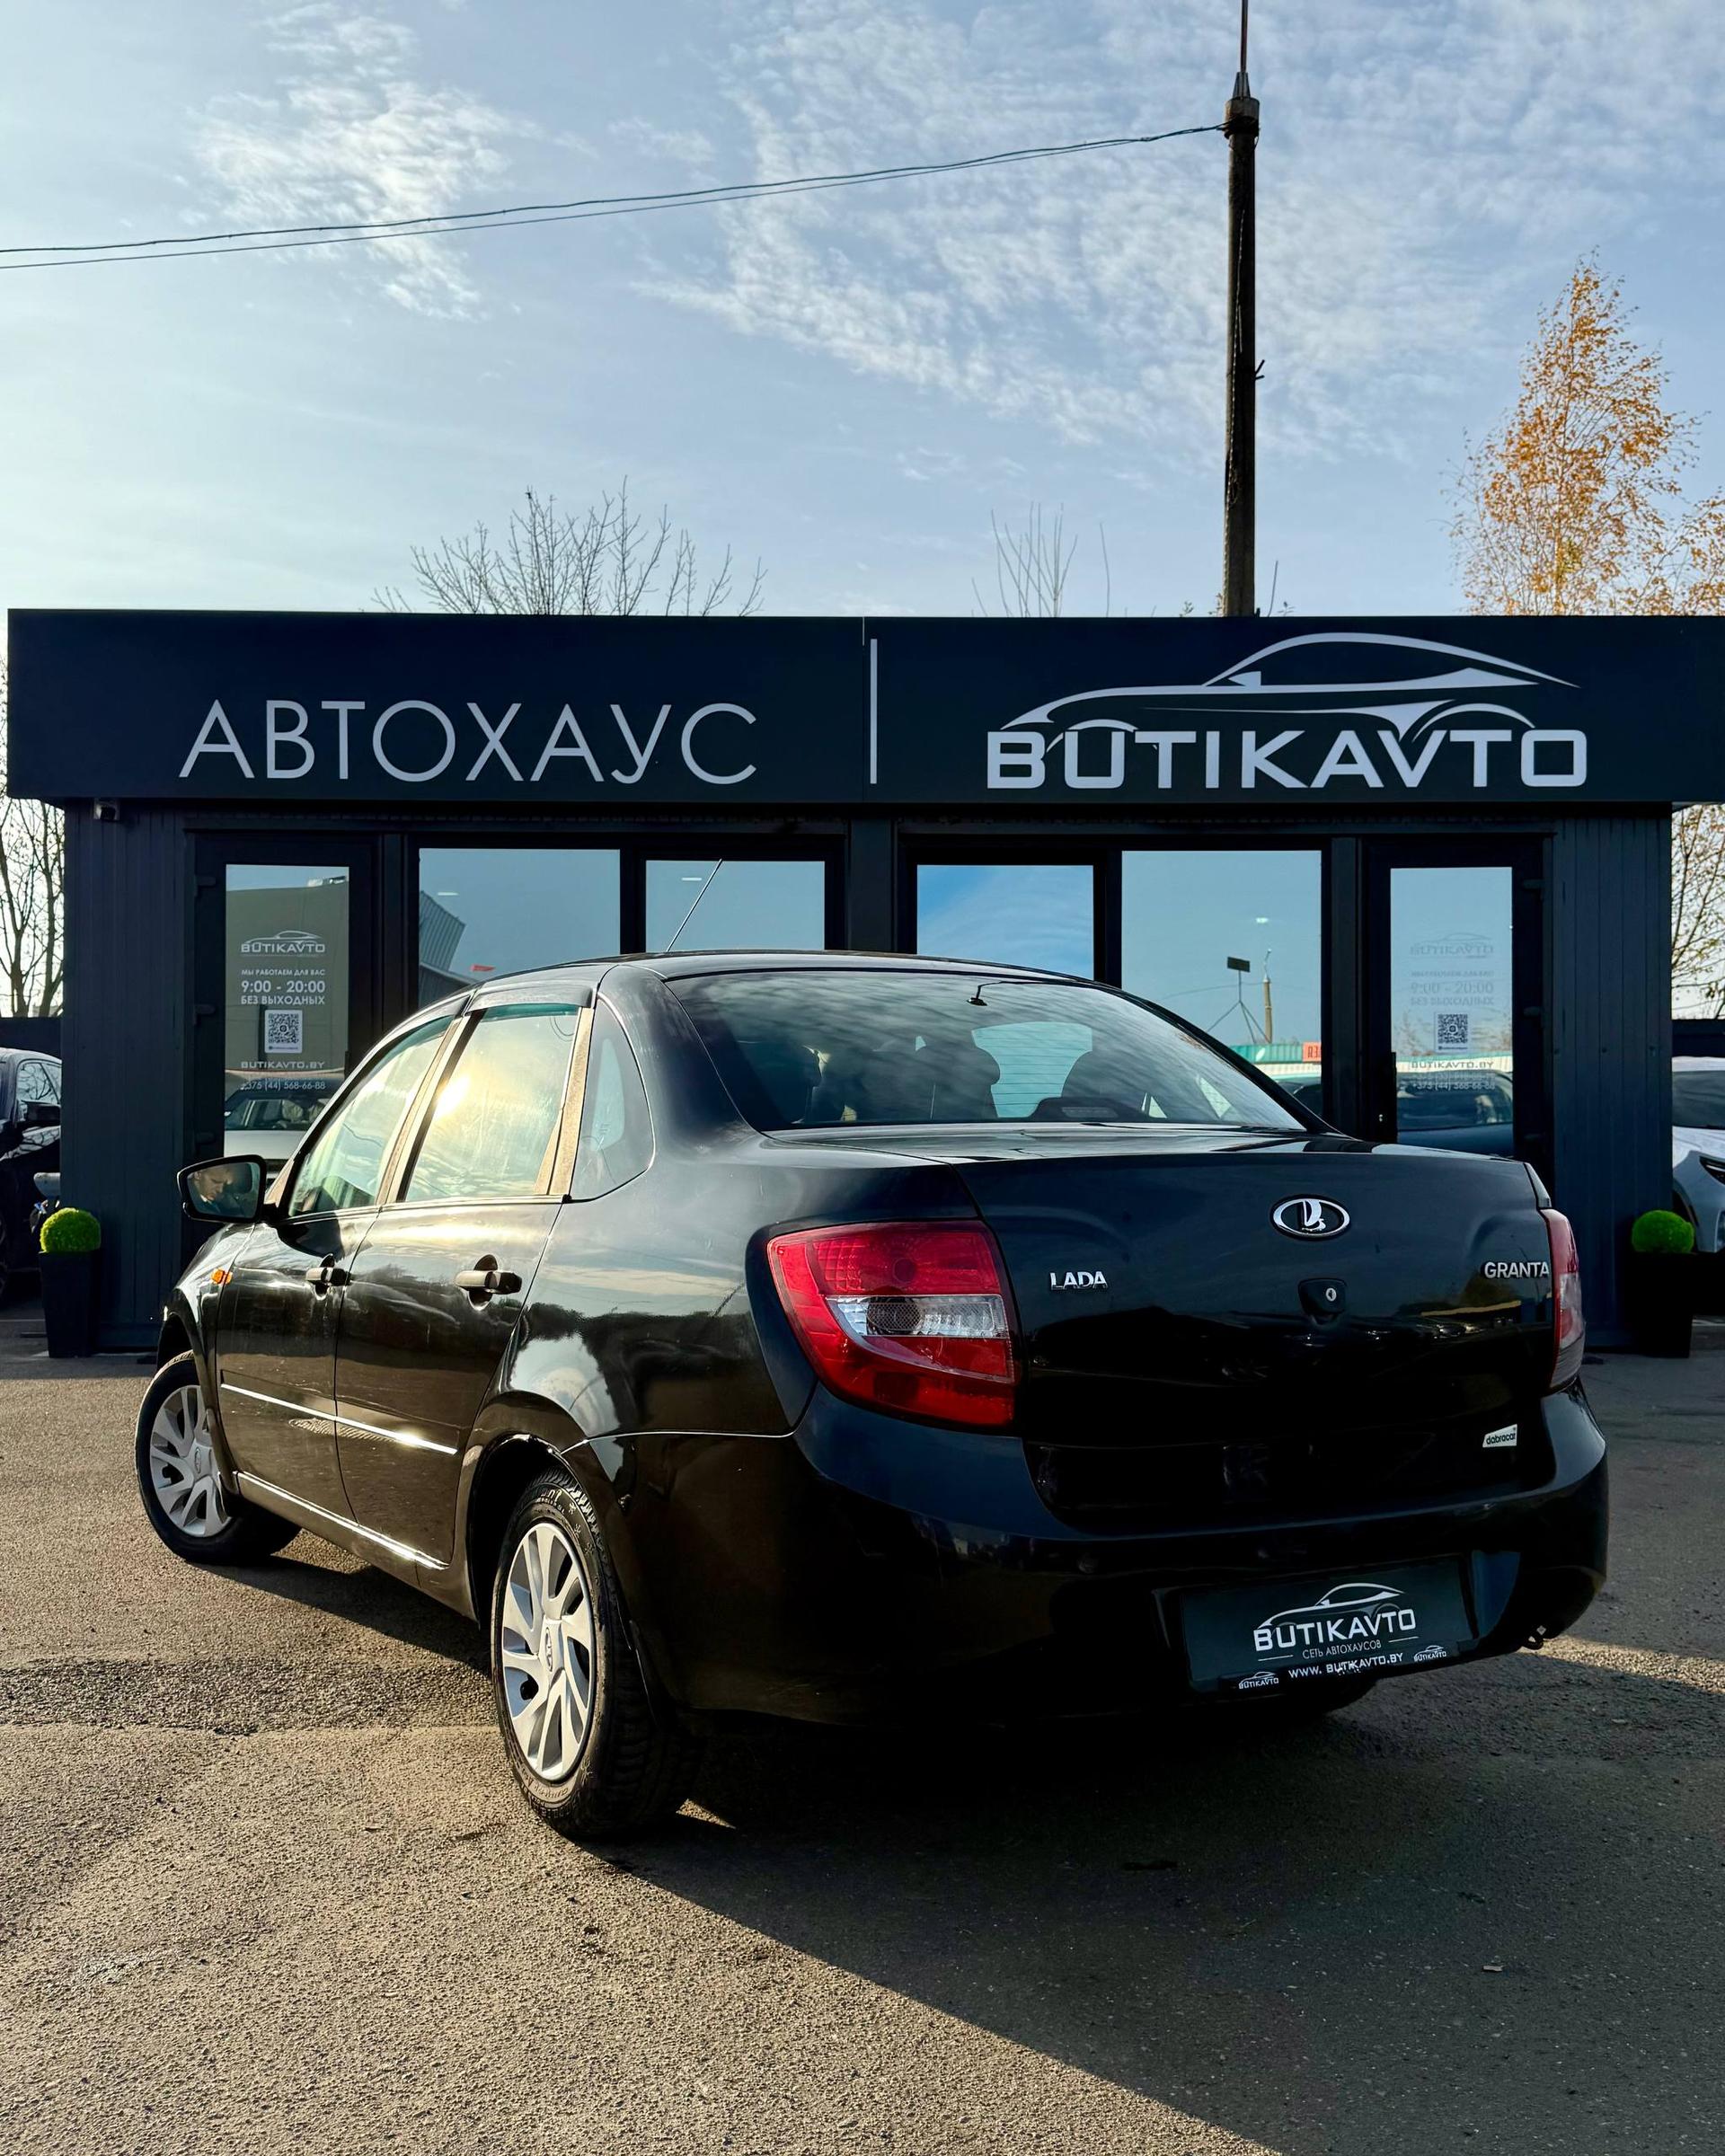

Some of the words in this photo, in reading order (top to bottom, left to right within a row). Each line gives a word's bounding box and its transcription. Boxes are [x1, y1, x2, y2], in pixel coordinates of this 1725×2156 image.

[179, 699, 757, 785] АВТОХАУС
[986, 729, 1588, 789] BUTIKAVTO
[241, 942, 326, 953] BUTIKAVTO
[241, 968, 254, 976] МЫ
[255, 968, 293, 976] РАБОТАЕМ
[241, 980, 272, 994] 9:00
[286, 980, 326, 994] 20:00
[241, 995, 259, 1005] БЕЗ
[261, 995, 326, 1006] ВЫХОДНЫХ
[241, 1061, 325, 1069] BUTIKAVTO.BY
[264, 1078, 281, 1091] (44)
[284, 1081, 326, 1091] 568-66-88
[1483, 1260, 1550, 1280] GRANTA
[1049, 1270, 1108, 1291] LADA
[1253, 1608, 1417, 1651] BUTIKAVTO
[1302, 1647, 1324, 1659] СЕТЬ
[1325, 1639, 1382, 1657] АВТОХАУСОВ
